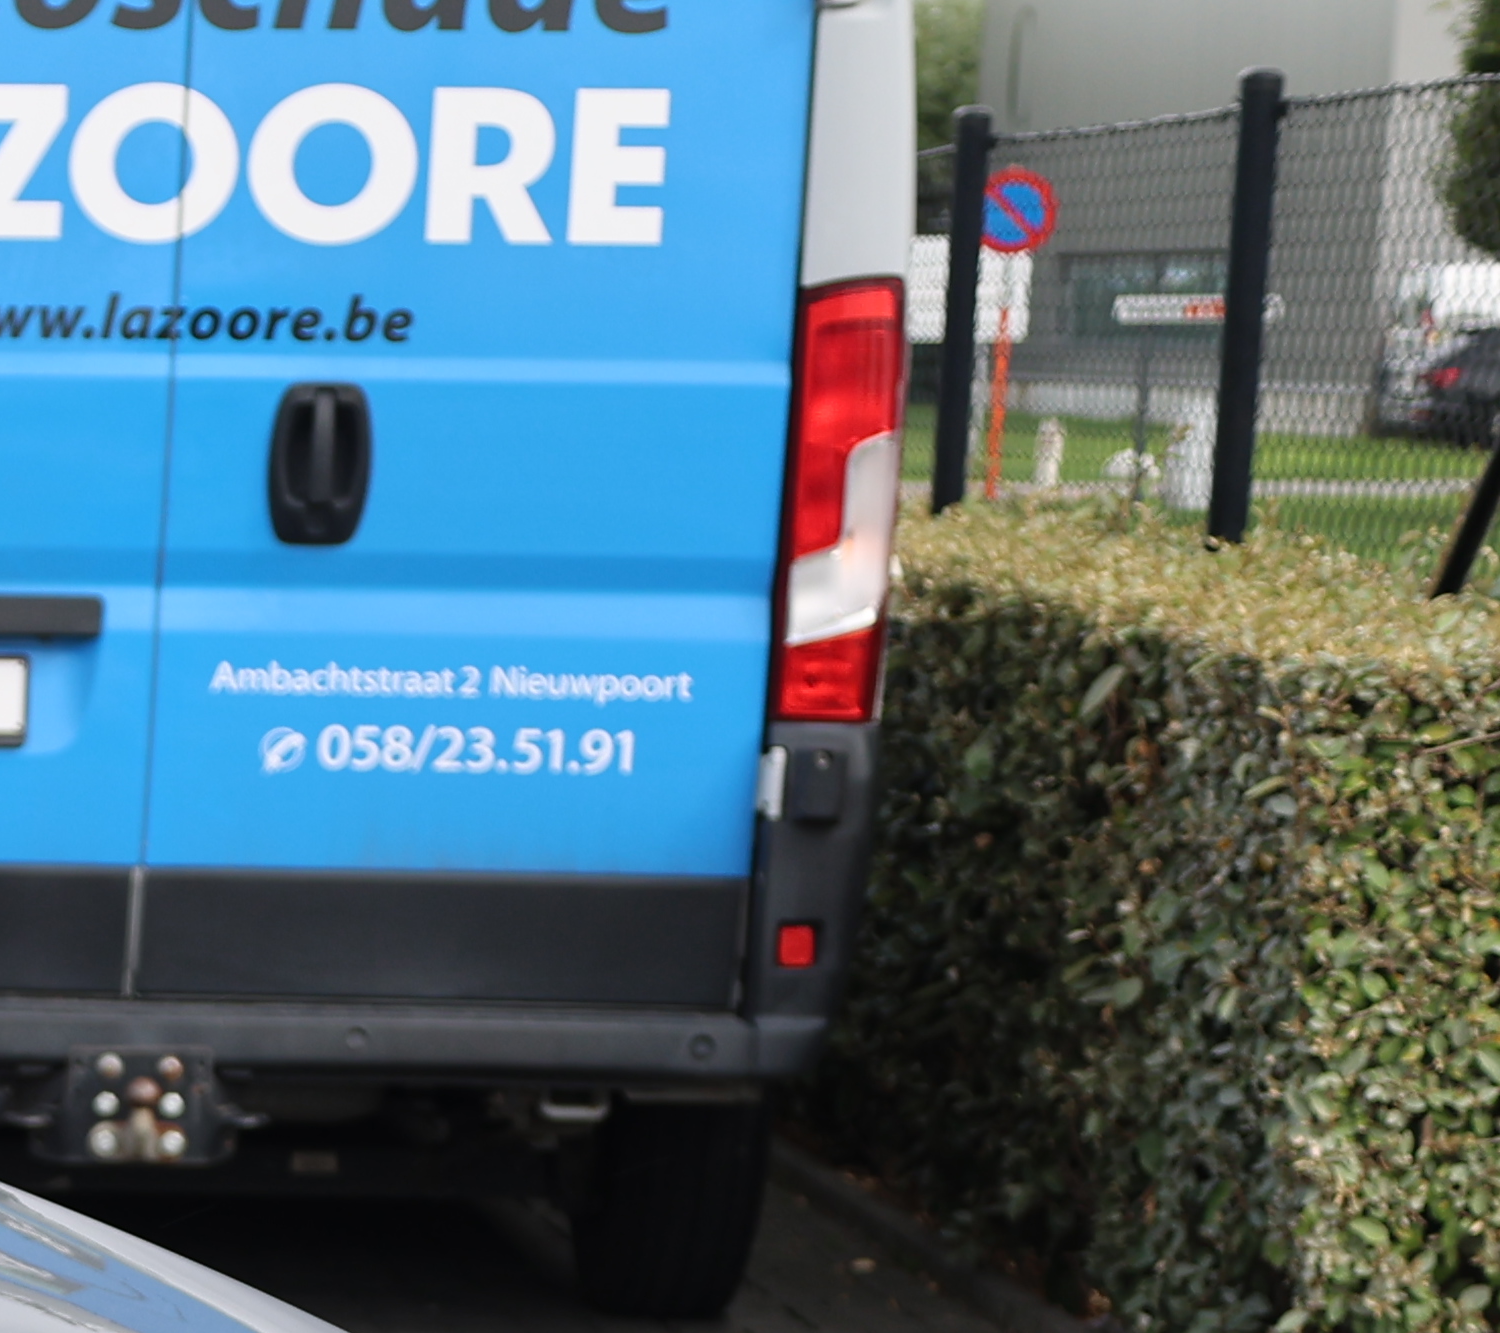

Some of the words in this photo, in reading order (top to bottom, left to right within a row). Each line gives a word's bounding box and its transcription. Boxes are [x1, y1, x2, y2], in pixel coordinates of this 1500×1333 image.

[208, 660, 456, 697] Ambachtstraat
[457, 666, 482, 697] 2
[488, 666, 694, 706] Nieuwpoort
[316, 723, 636, 775] 058/23.51.91
